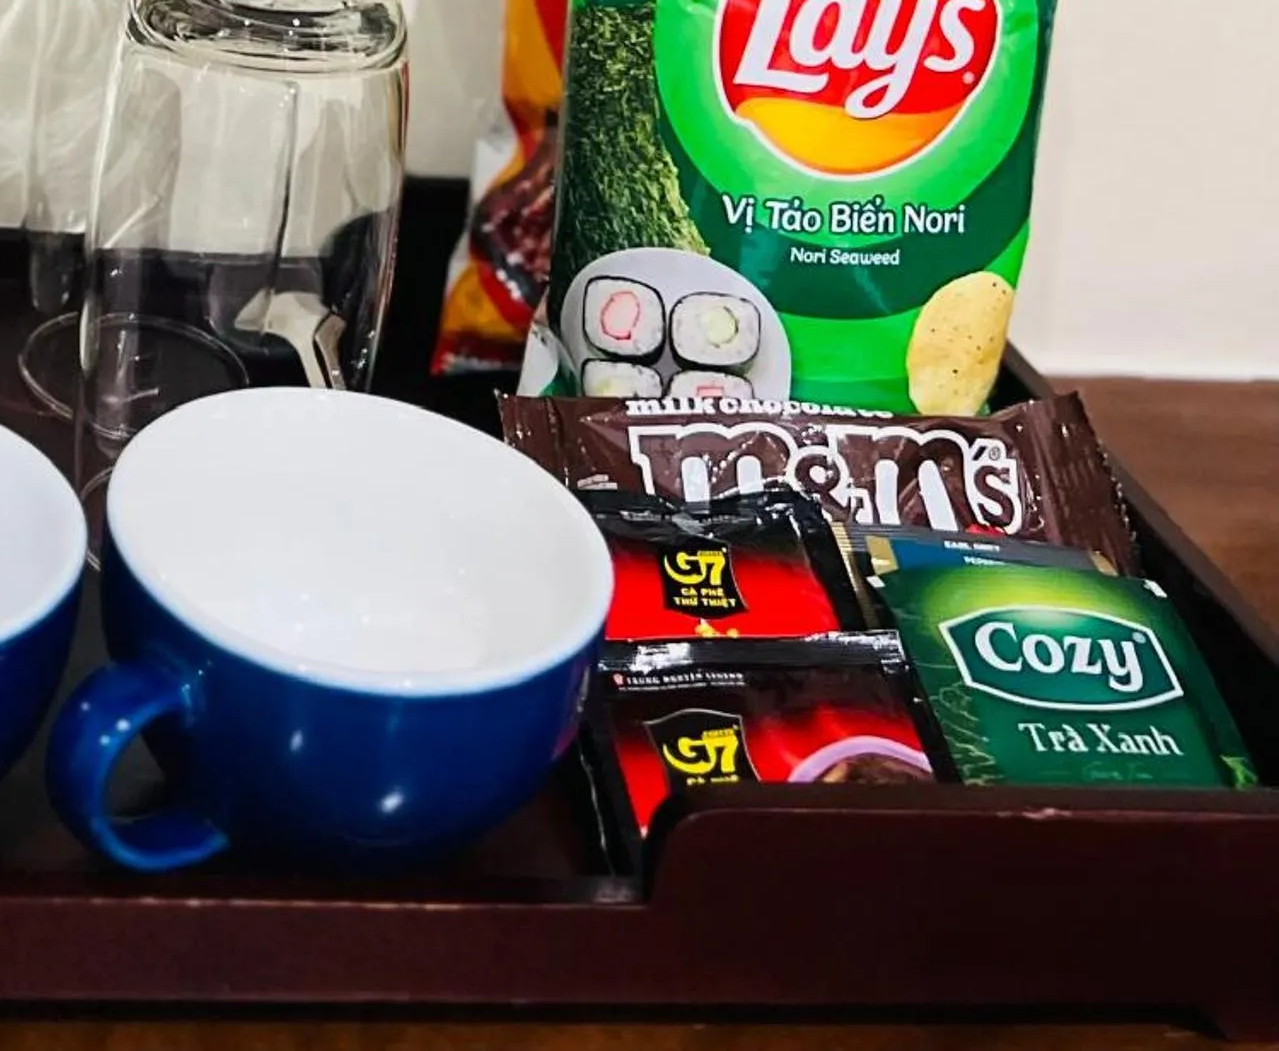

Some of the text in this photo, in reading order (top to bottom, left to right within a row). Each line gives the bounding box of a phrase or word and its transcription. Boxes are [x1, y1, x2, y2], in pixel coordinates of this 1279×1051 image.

[722, 195, 965, 234] Vị Tảo Biển Nori
[791, 247, 901, 266] Nori Seaweed
[625, 396, 716, 416] milk
[663, 549, 726, 586] G7
[974, 621, 1144, 692] Cozy
[662, 728, 738, 774] G7
[1018, 722, 1184, 756] Trà Xanh
